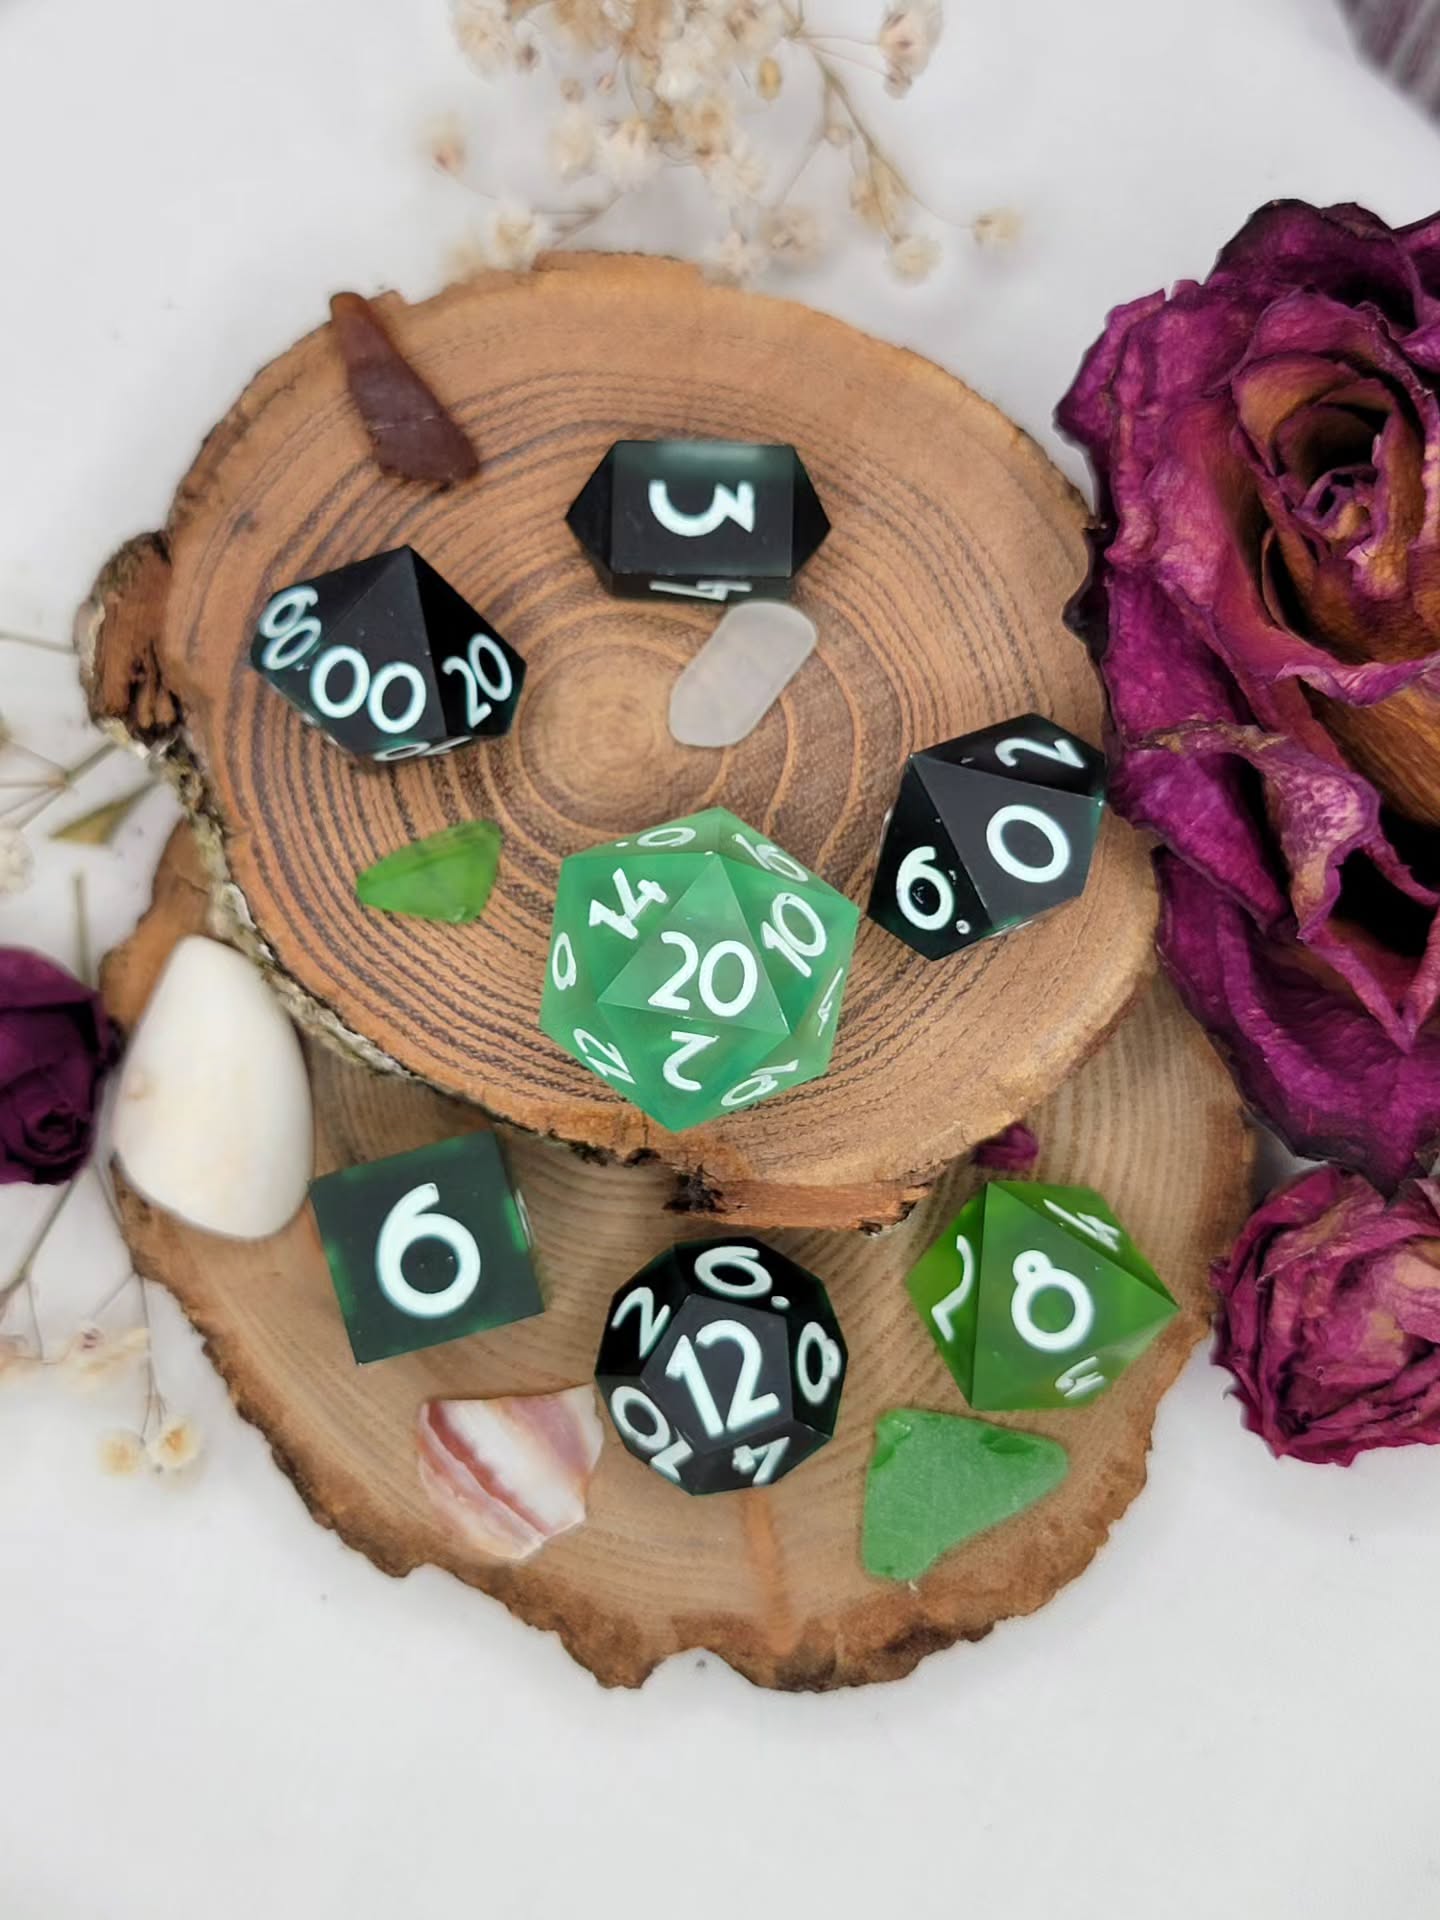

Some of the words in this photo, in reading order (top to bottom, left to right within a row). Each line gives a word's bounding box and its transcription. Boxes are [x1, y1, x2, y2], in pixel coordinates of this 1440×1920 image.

[310, 645, 426, 734] 00
[442, 633, 512, 728] 20
[994, 737, 1084, 768] 2
[987, 804, 1070, 883] 0
[589, 868, 668, 940] 14
[761, 892, 827, 978] 10
[648, 931, 757, 1017] 20
[573, 1028, 637, 1085] 12
[663, 1031, 719, 1091] 2
[376, 1182, 481, 1318] 6
[611, 1287, 670, 1359] 2
[1011, 1250, 1094, 1353] 8
[665, 1319, 780, 1439] 12
[797, 1321, 841, 1404] 8
[611, 1385, 693, 1482] 10
[732, 1436, 790, 1485] 4
